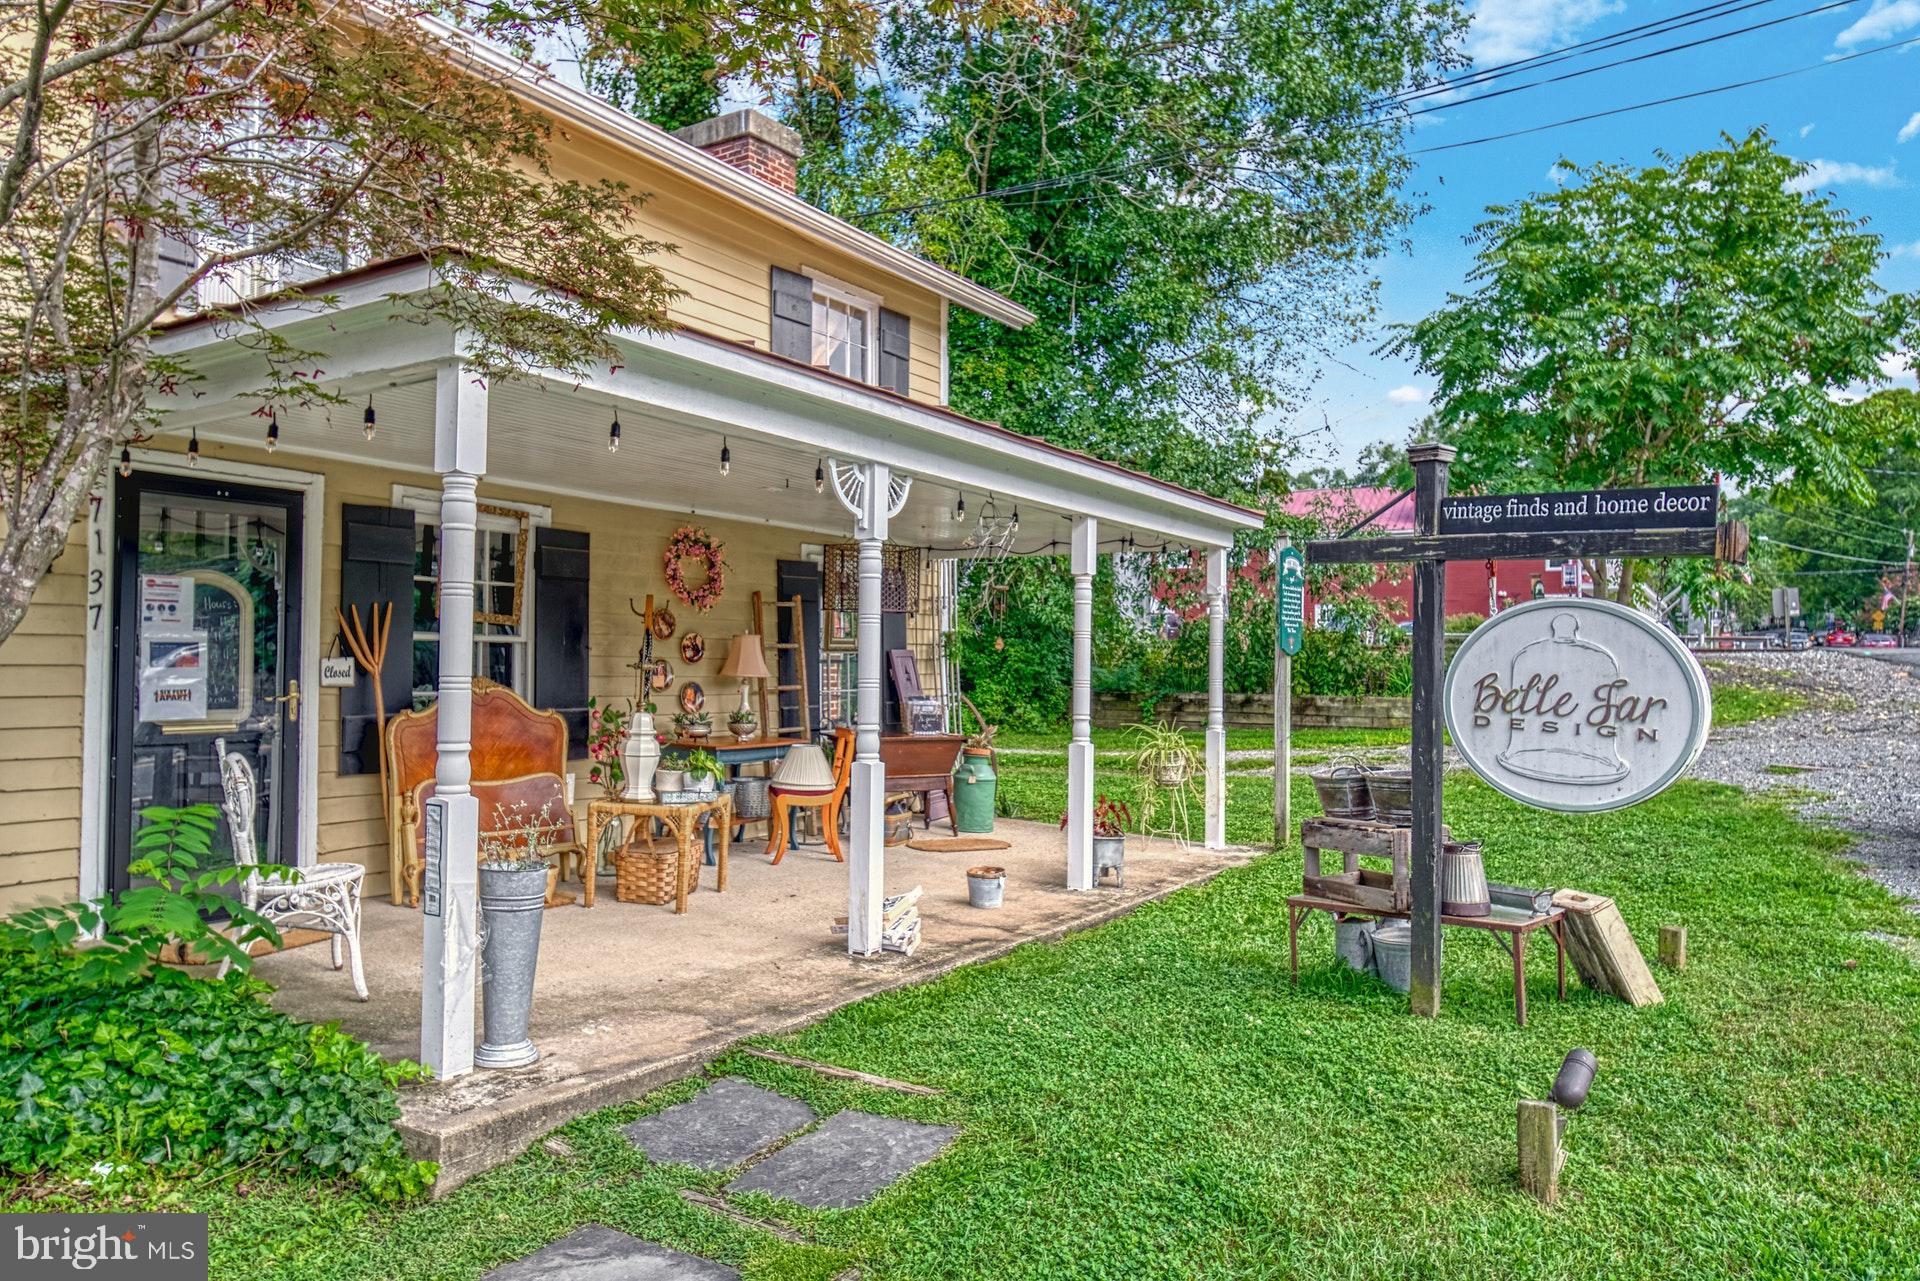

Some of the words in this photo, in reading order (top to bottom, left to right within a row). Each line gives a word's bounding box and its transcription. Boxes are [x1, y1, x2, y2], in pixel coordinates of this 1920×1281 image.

[1443, 501, 1502, 523] vintage
[1506, 497, 1549, 518] finds
[1554, 495, 1588, 516] and
[1595, 496, 1649, 515] home
[1653, 491, 1711, 513] decor
[89, 497, 103, 630] 7137
[324, 664, 352, 679] Closed
[1474, 672, 1579, 717] Belle
[1586, 679, 1667, 726] Jar
[1474, 715, 1658, 742] DESIGN
